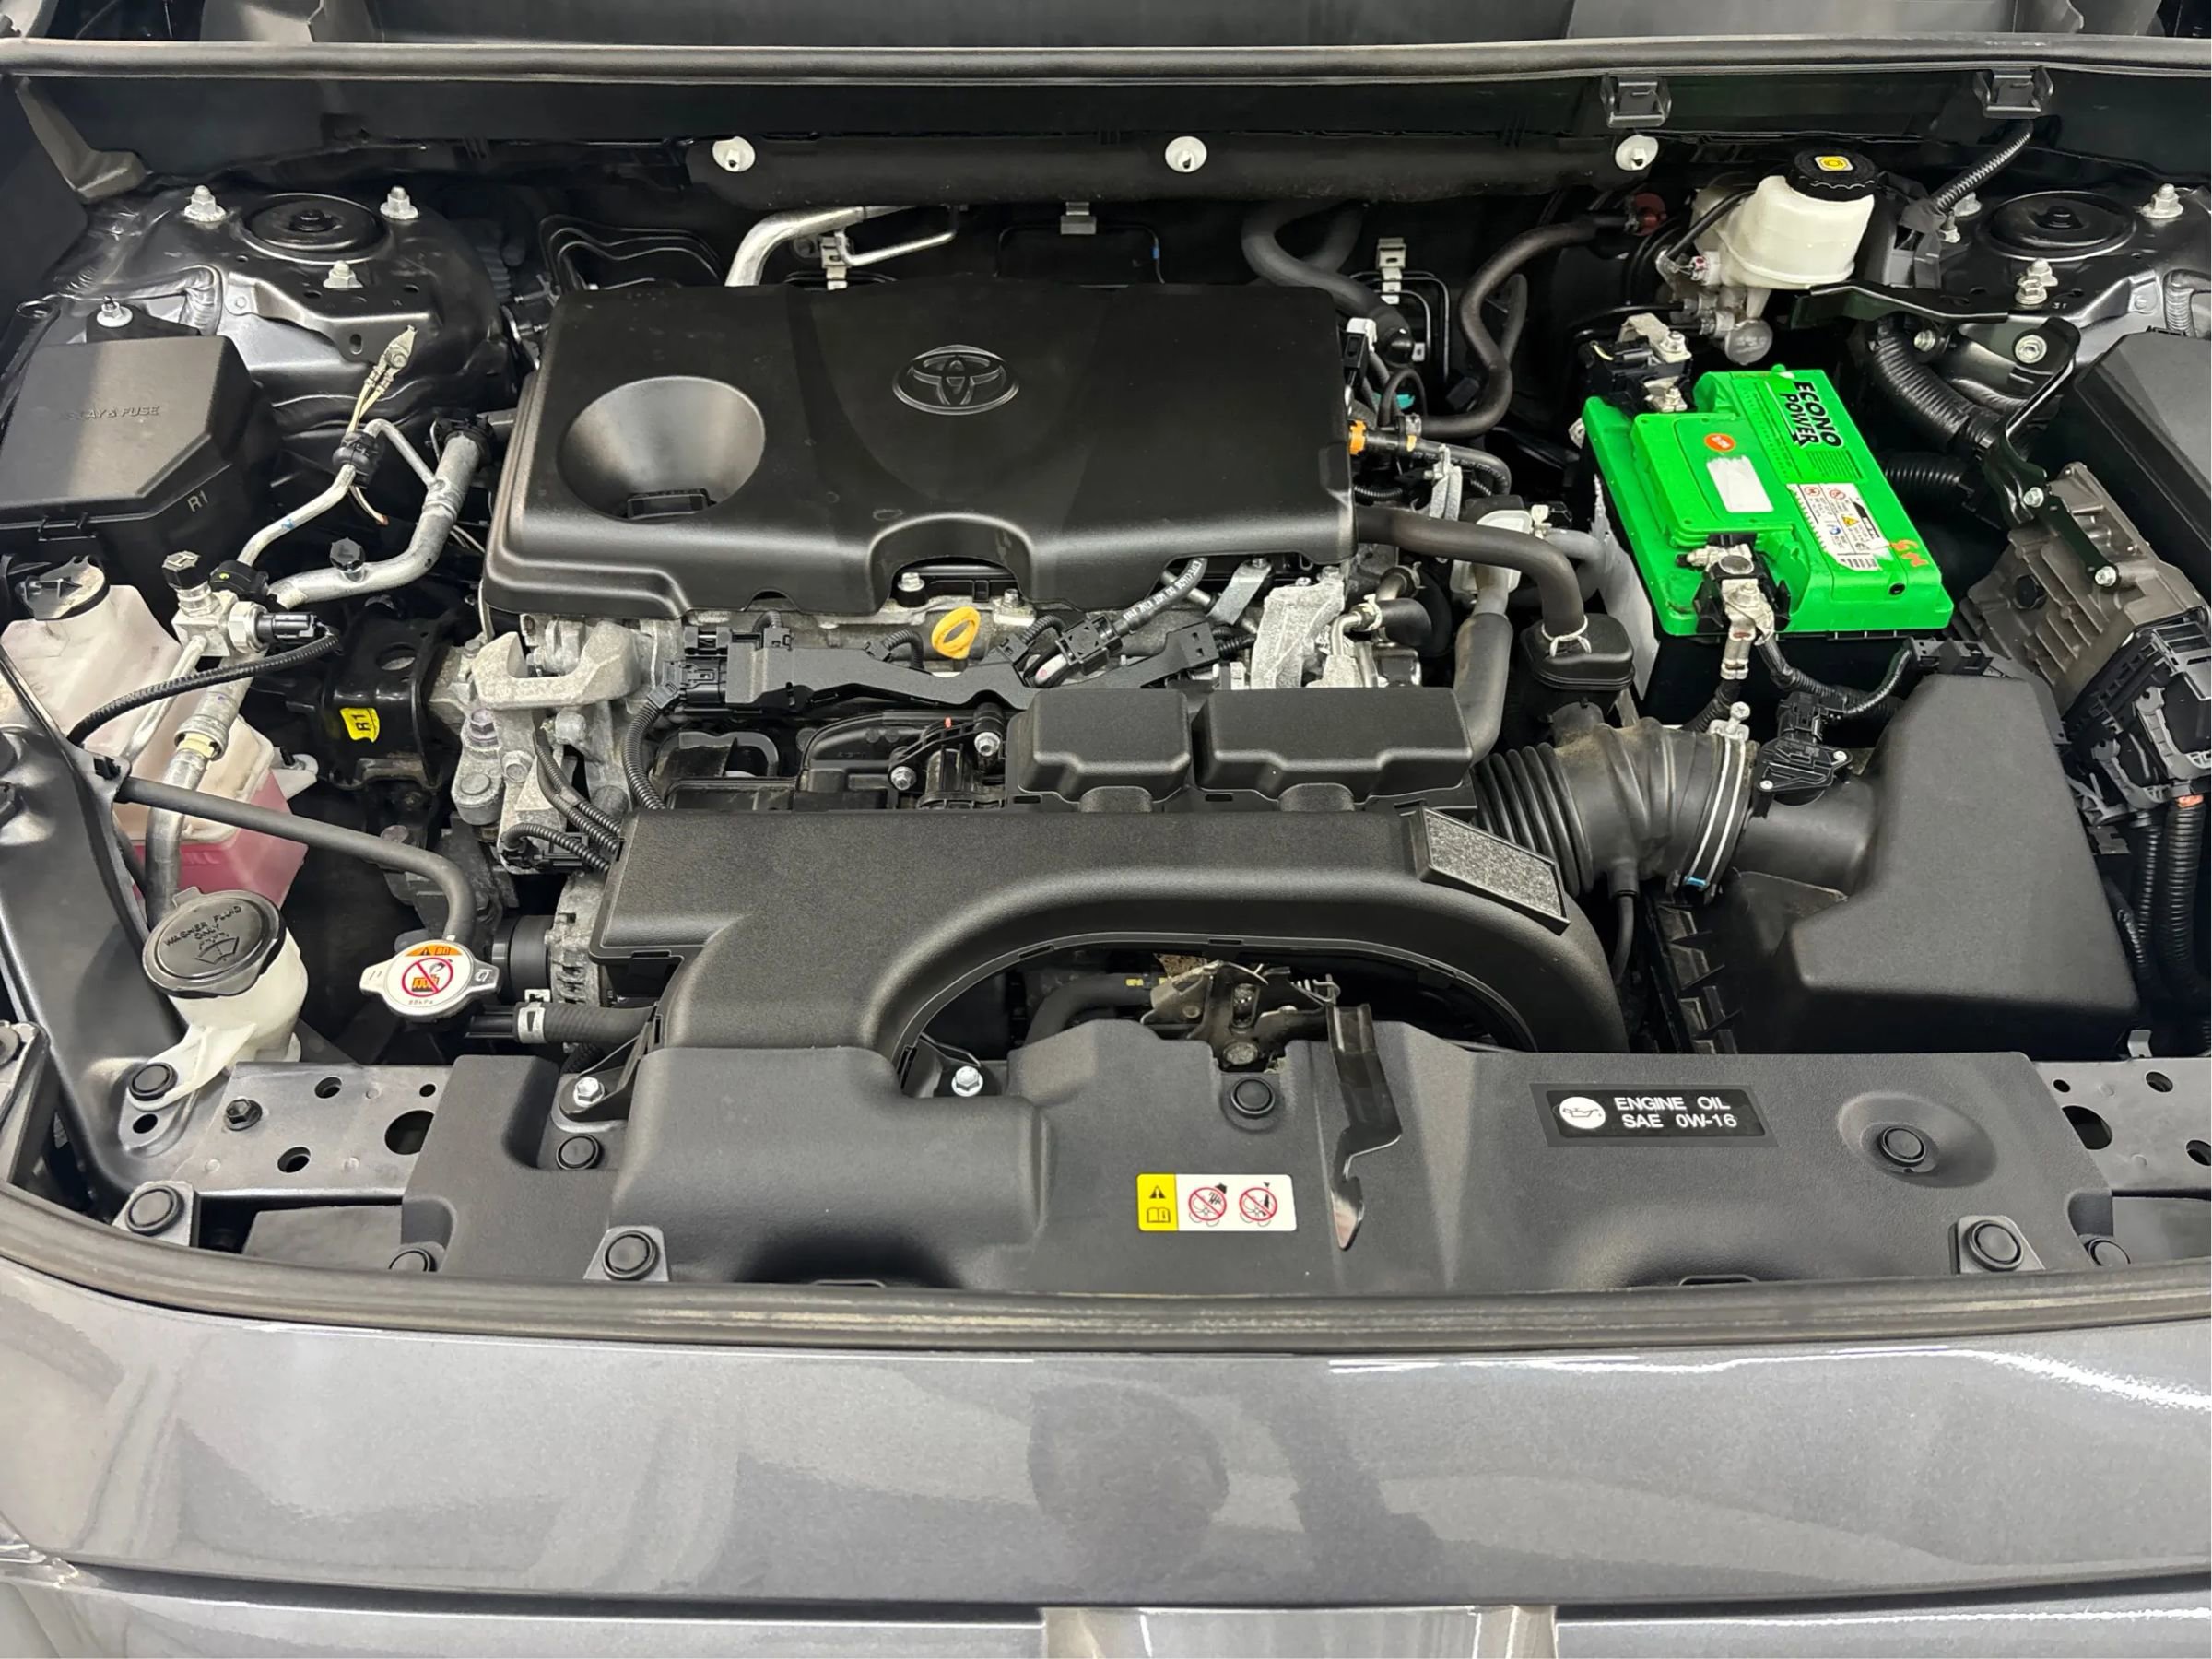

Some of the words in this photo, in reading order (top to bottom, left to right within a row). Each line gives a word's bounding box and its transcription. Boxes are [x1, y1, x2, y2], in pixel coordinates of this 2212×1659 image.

[1779, 393, 1820, 447] POWER
[1793, 381, 1843, 447] ECONO
[187, 489, 209, 512] R1
[351, 713, 371, 732] R1
[1613, 1096, 1687, 1112] ENGINE
[1696, 1095, 1732, 1111] OIL
[1621, 1113, 1664, 1128] SAE
[1675, 1113, 1738, 1129] 0W-16
